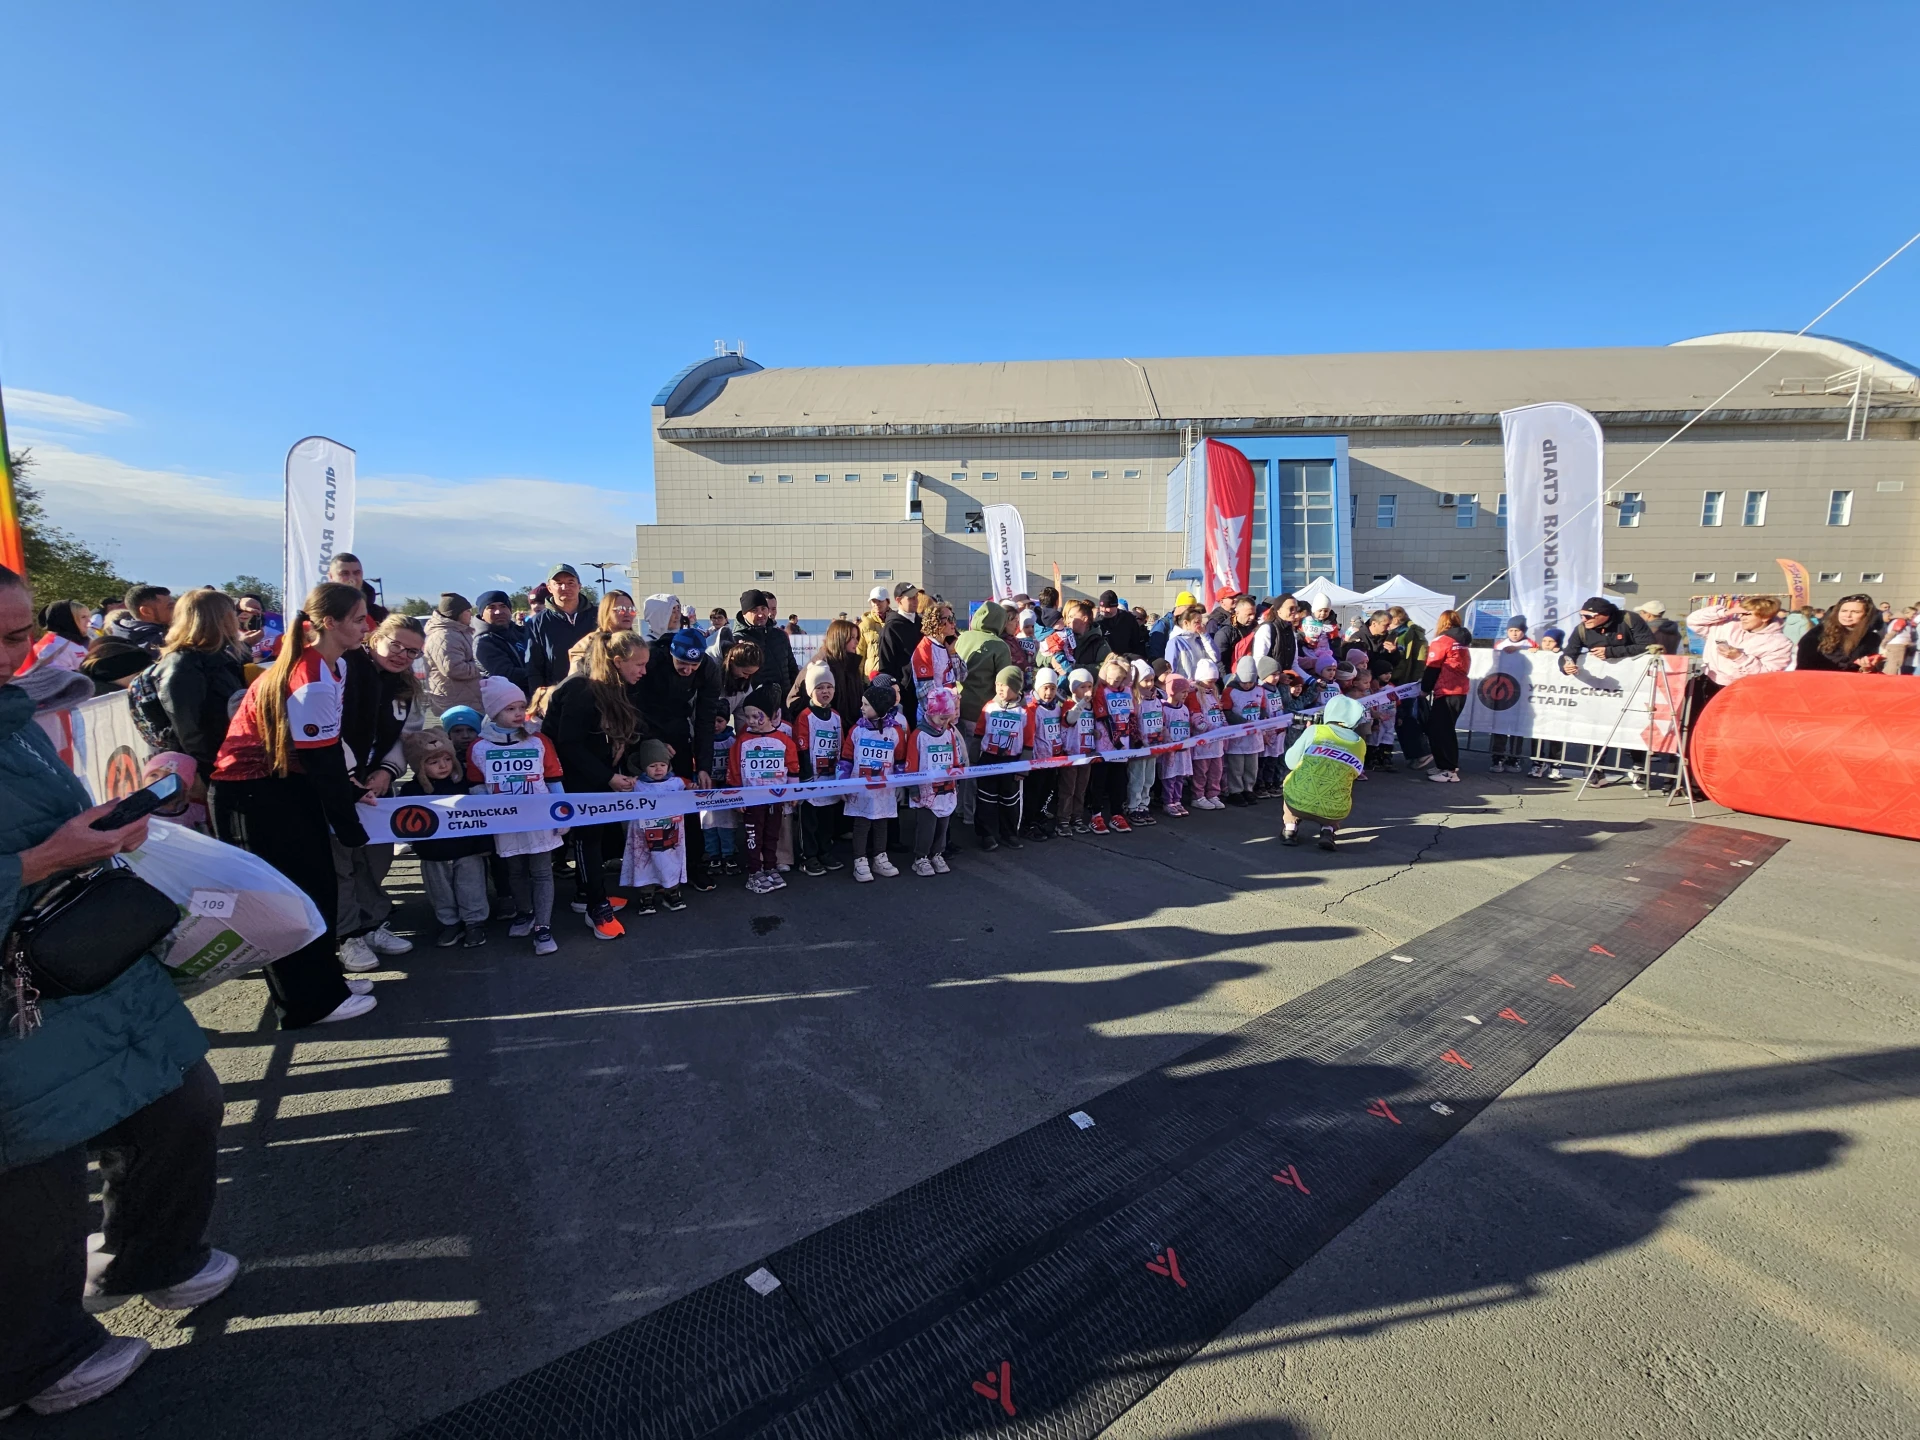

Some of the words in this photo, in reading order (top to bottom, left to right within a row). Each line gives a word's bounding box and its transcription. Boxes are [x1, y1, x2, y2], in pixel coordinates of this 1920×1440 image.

[324, 466, 337, 522] СТАЛЬ
[316, 528, 335, 584] ЬСКАЯ
[1528, 683, 1624, 698] УРАЛЬСКАЯ
[1528, 695, 1578, 707] СТАЛЬ
[991, 718, 1016, 729] 0107
[862, 747, 888, 760] 0181
[1312, 746, 1362, 771] МЕДИА
[492, 759, 533, 772] 0109
[750, 759, 780, 770] 0120
[577, 797, 657, 816] Урал56.Ру
[695, 796, 744, 807] РОССИЙСКИЙ
[446, 806, 518, 819] УРАЛЬСКАЯ
[447, 819, 488, 830] СТАЛЬ
[202, 900, 225, 910] 109
